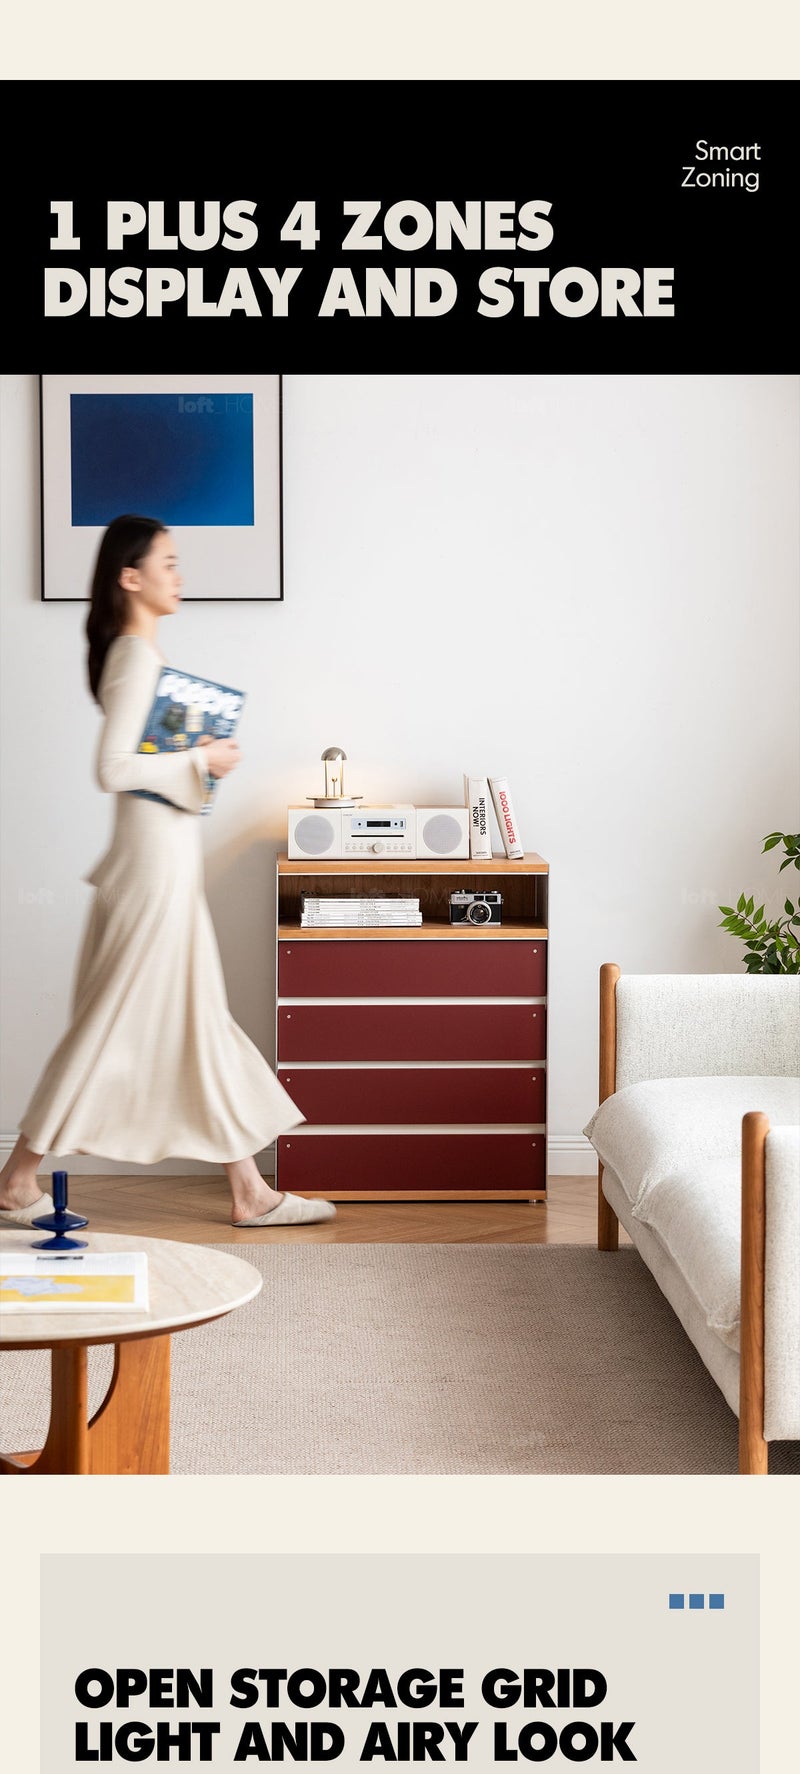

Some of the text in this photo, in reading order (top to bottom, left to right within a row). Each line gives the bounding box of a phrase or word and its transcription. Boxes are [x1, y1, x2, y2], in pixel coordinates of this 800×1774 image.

[478, 797, 486, 836] INTERIORS
[498, 792, 516, 844] 1000 LIGHTS
